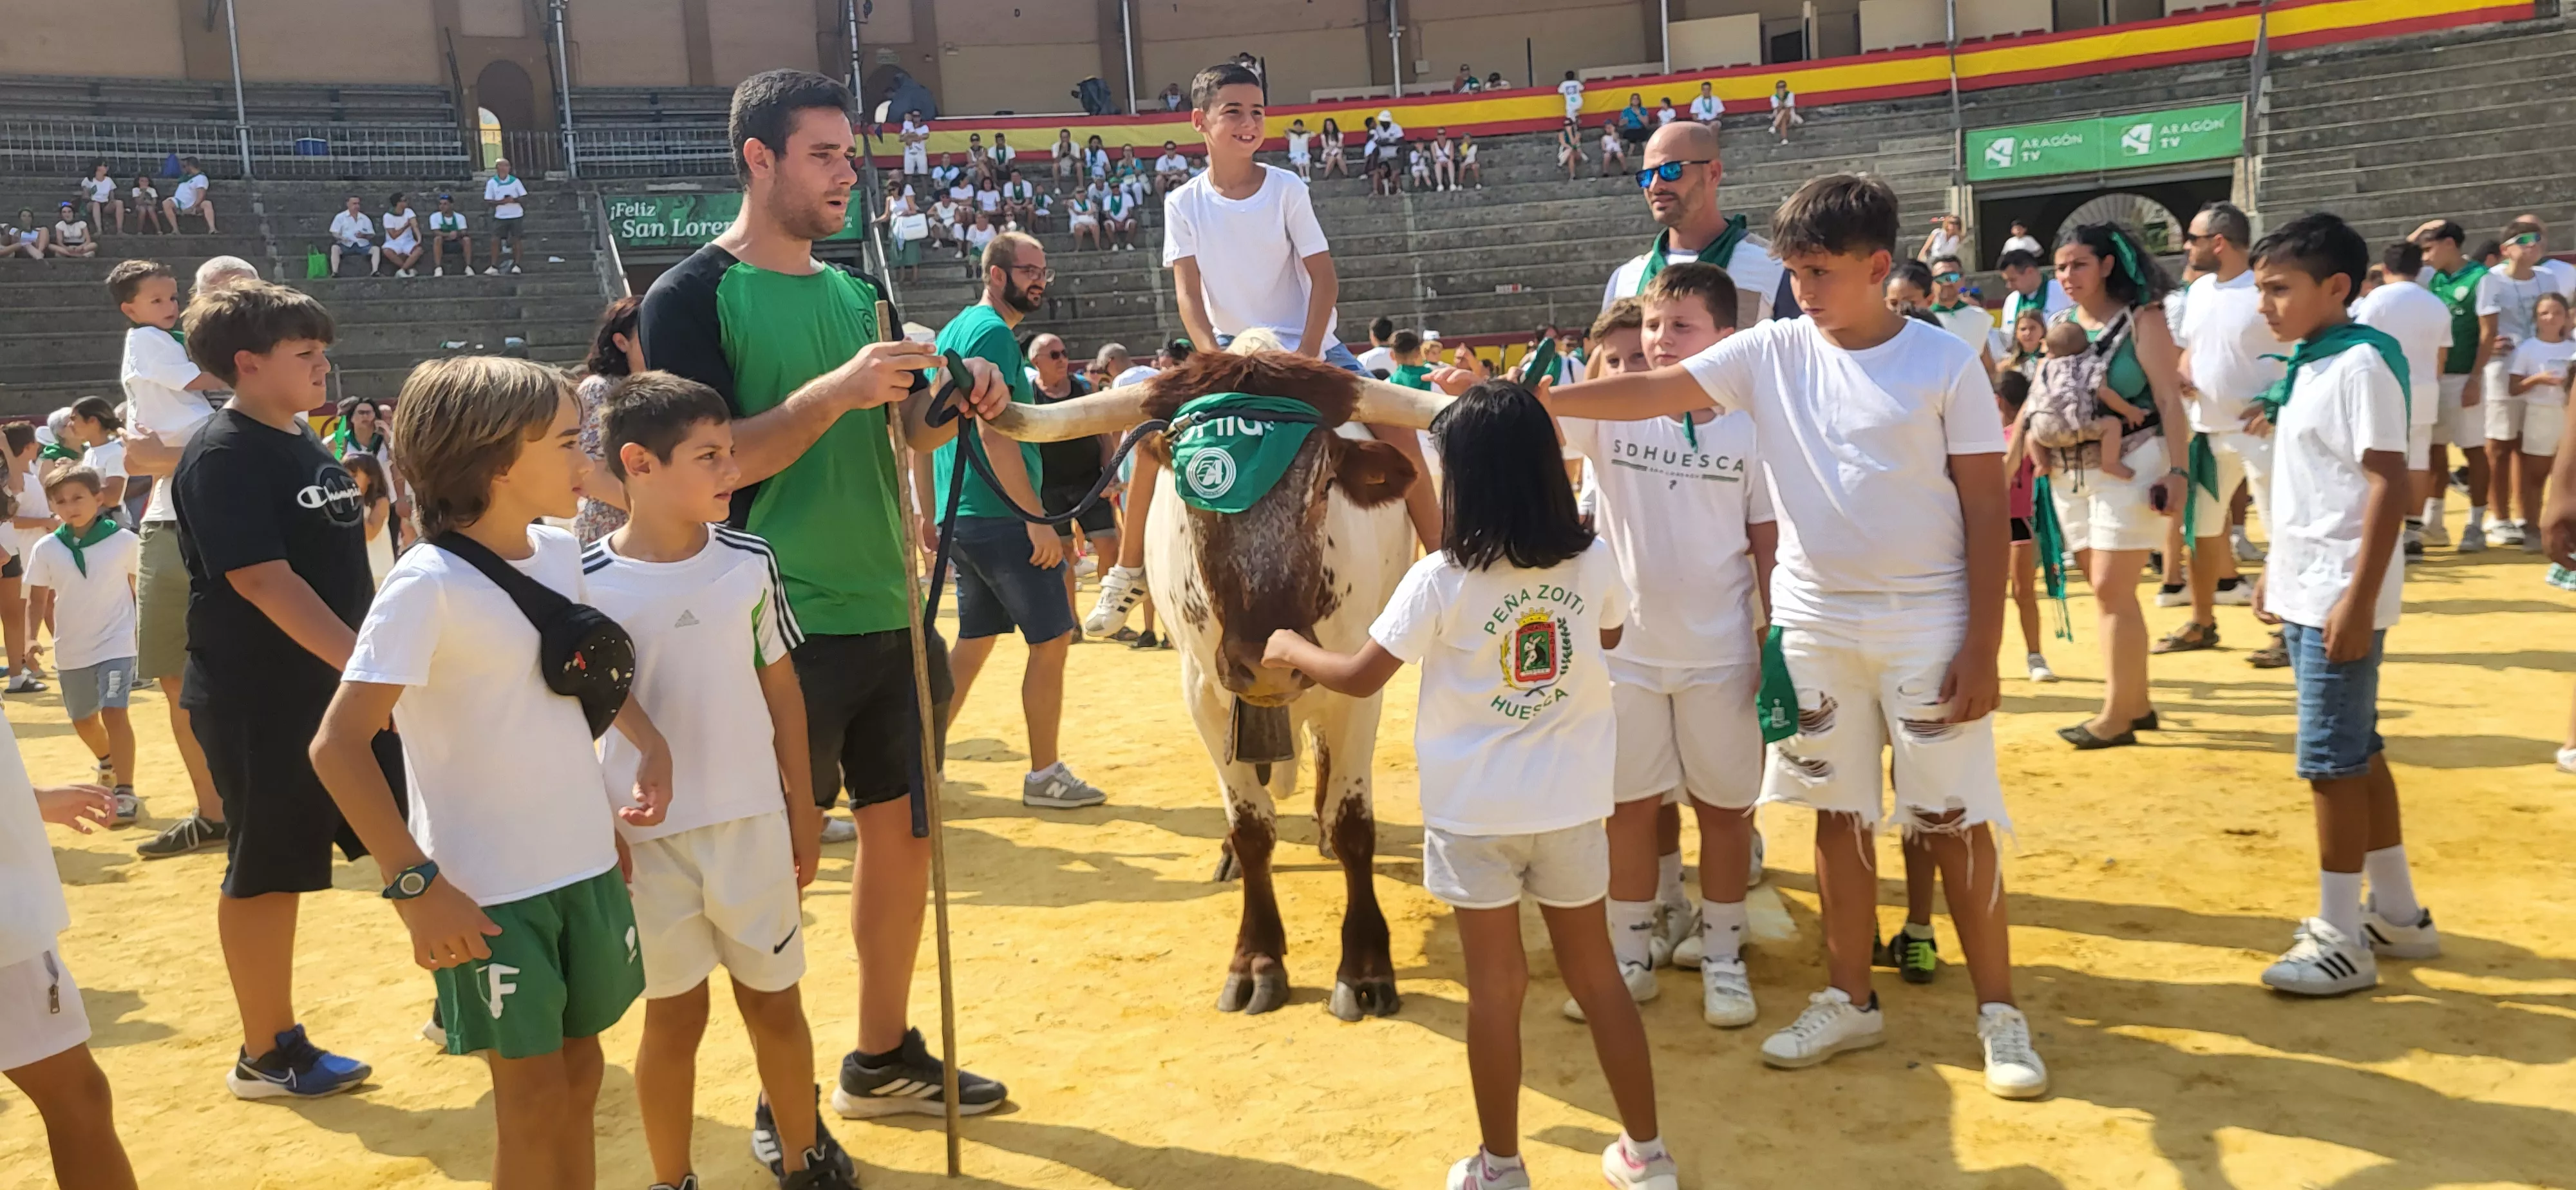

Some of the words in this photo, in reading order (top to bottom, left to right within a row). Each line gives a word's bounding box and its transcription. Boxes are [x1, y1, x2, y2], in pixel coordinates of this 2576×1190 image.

[2159, 117, 2225, 135] ARAGÓN
[2021, 133, 2083, 149] ARAGÓN
[2160, 137, 2181, 149] TV
[2022, 151, 2041, 162] TV
[610, 202, 656, 220] ¡Feliz
[621, 220, 667, 238] San
[1484, 588, 1531, 636] PEÑA
[1537, 584, 1585, 616] ZOITI
[1490, 688, 1569, 720] HUESCA
